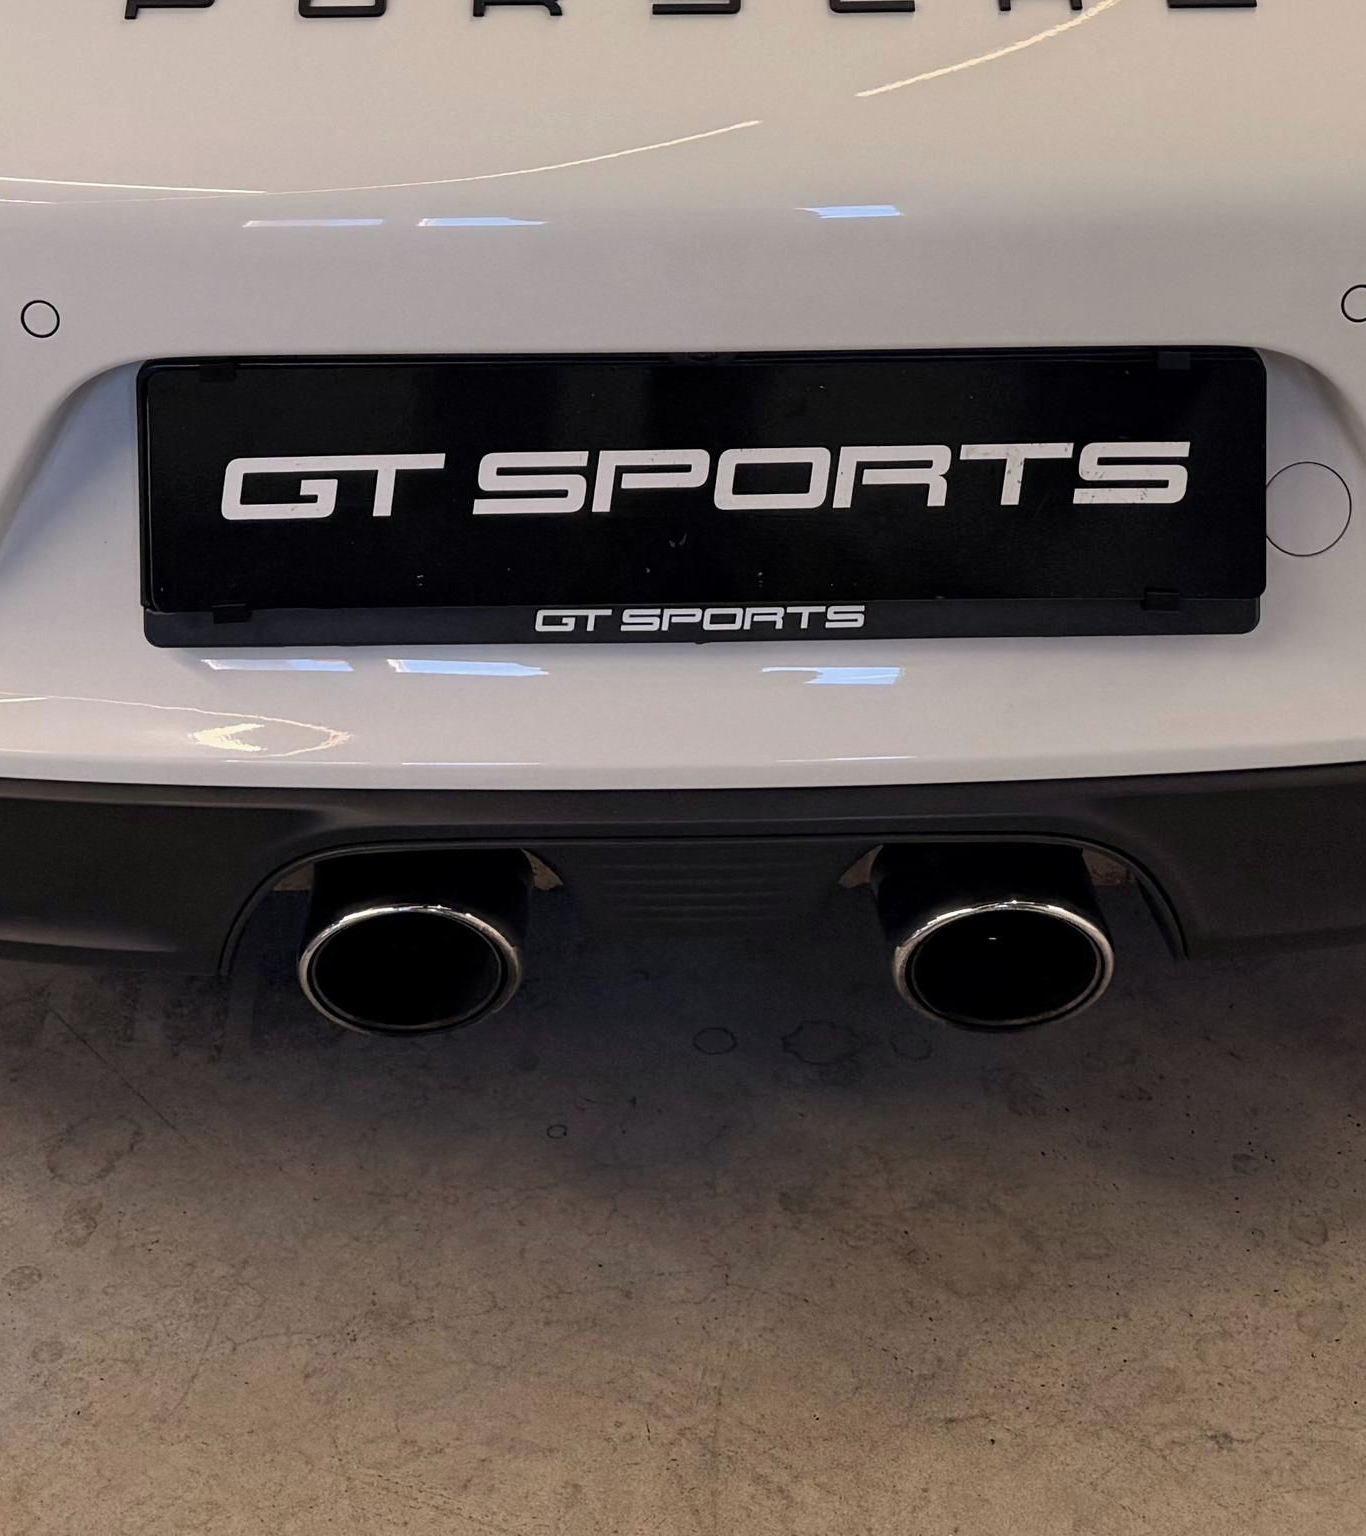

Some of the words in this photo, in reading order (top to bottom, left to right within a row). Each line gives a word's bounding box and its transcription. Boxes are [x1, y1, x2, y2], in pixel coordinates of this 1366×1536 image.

[221, 452, 446, 521] GT
[472, 441, 1191, 515] SPORTS
[535, 609, 612, 632] GT
[620, 605, 865, 632] SPORTS
